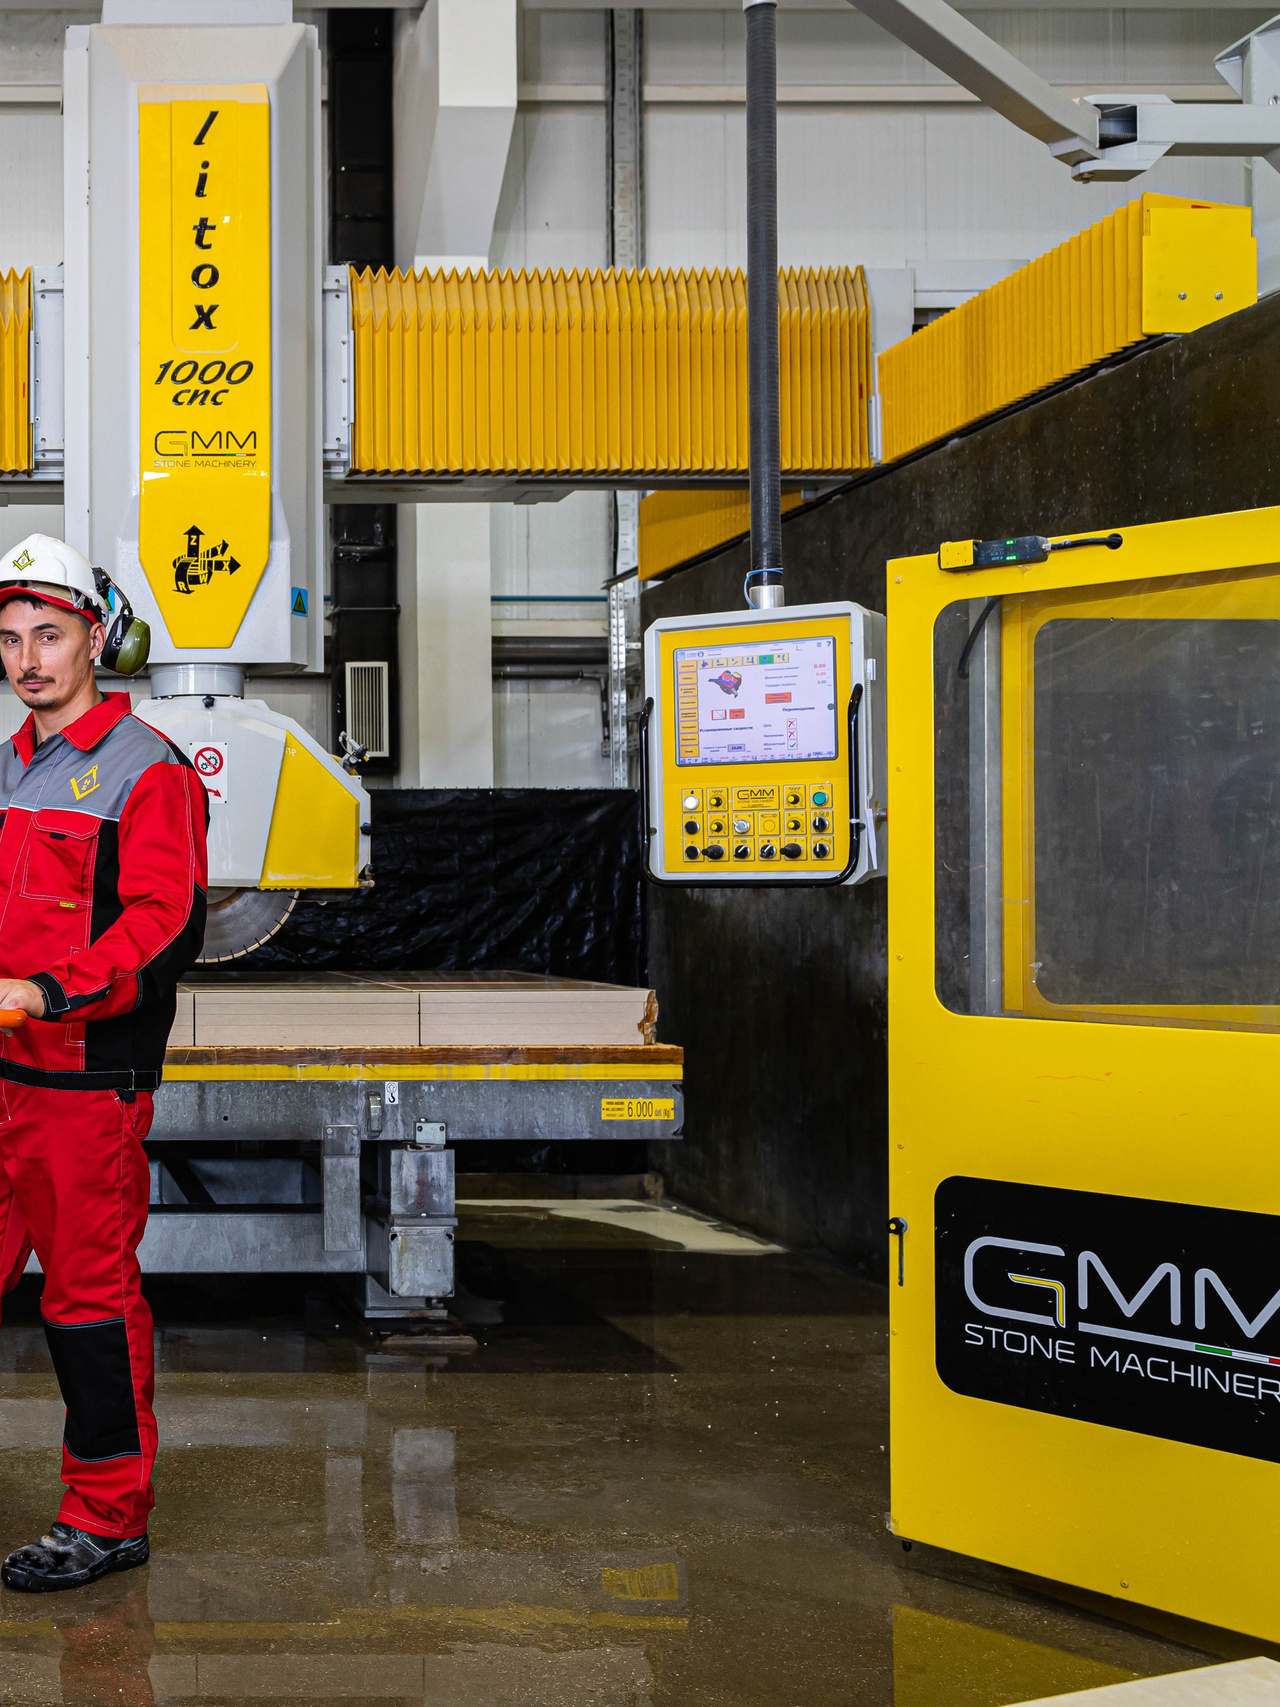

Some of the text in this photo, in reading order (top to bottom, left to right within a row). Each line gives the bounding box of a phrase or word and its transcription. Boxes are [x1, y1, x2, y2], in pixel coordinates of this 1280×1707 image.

[189, 110, 220, 330] litox
[154, 359, 254, 385] 1000
[172, 389, 230, 406] cnc
[154, 430, 257, 457] GMM
[154, 460, 257, 468] STONE MACHINERY
[190, 535, 197, 545] Z
[216, 544, 223, 555] Y
[222, 561, 230, 571] X
[200, 573, 208, 584] W
[177, 581, 187, 592] R
[737, 789, 774, 799] GMM
[628, 1101, 654, 1117] 6.000
[964, 1236, 1280, 1339] GMM
[964, 1323, 1280, 1403] STONE MACHINER
